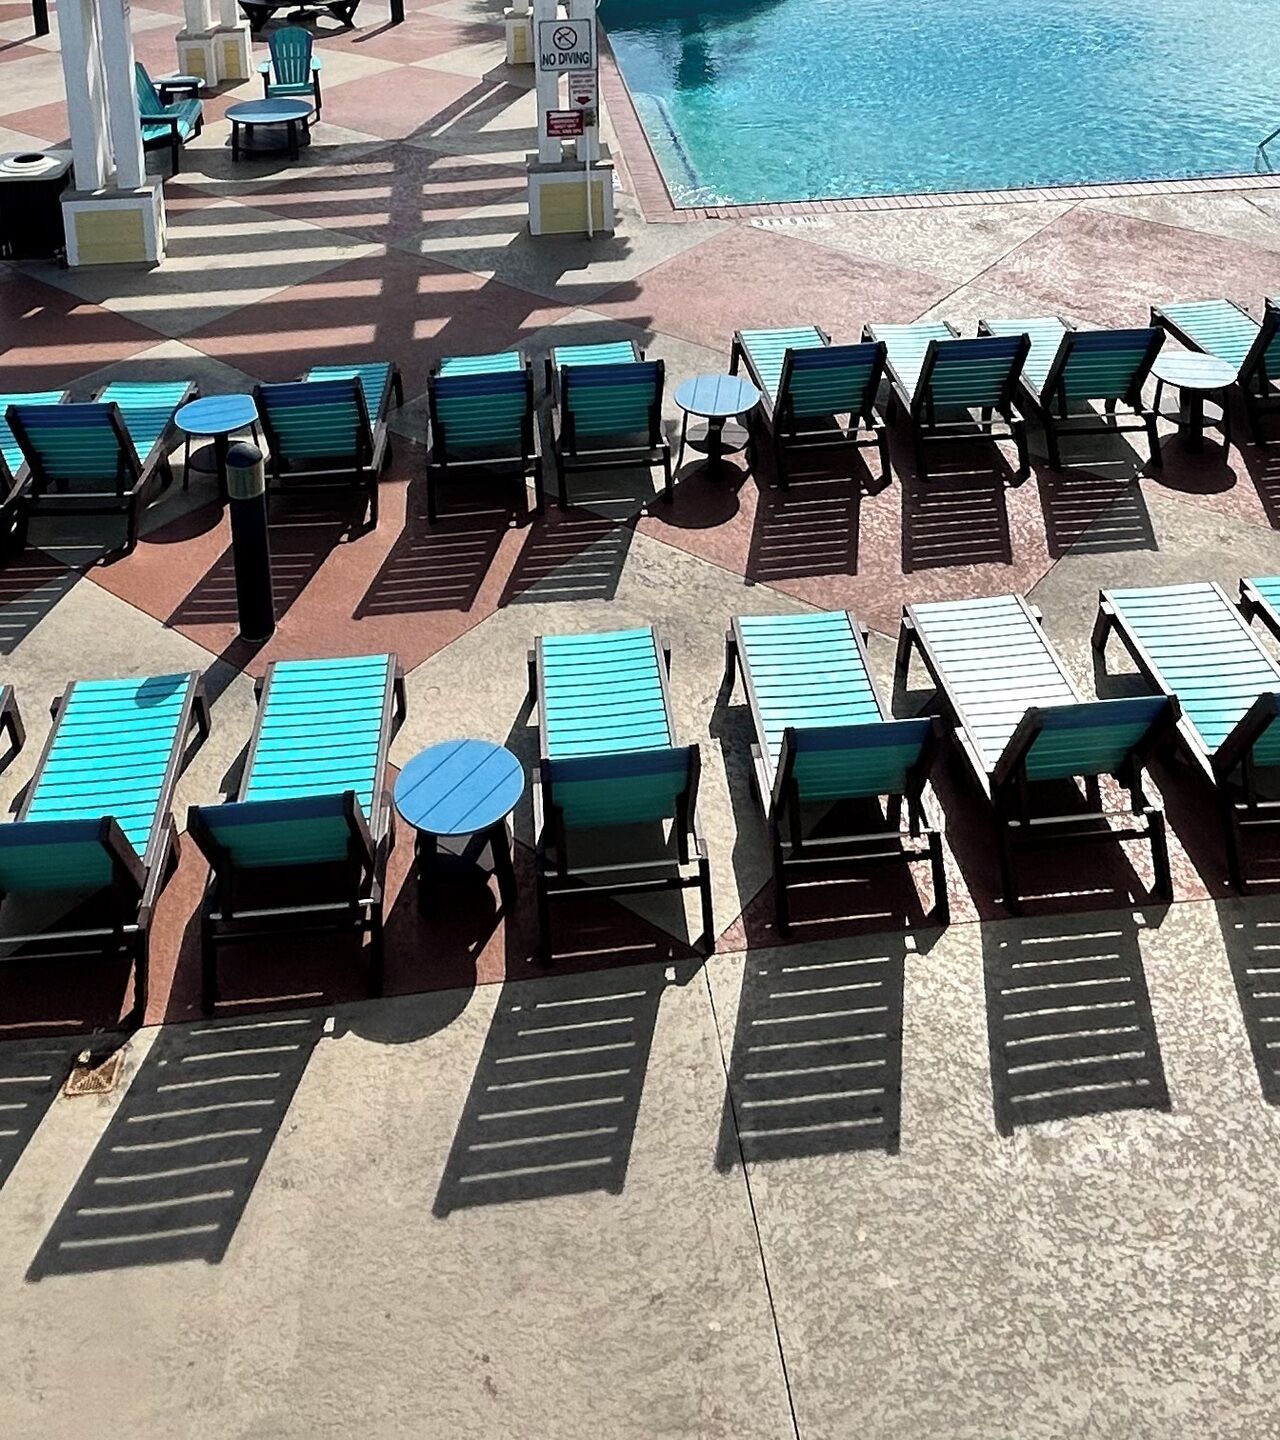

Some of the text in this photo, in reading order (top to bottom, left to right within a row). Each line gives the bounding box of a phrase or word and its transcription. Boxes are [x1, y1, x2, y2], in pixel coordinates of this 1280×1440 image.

[543, 52, 589, 65] NO DIVING
[768, 218, 783, 226] FT
